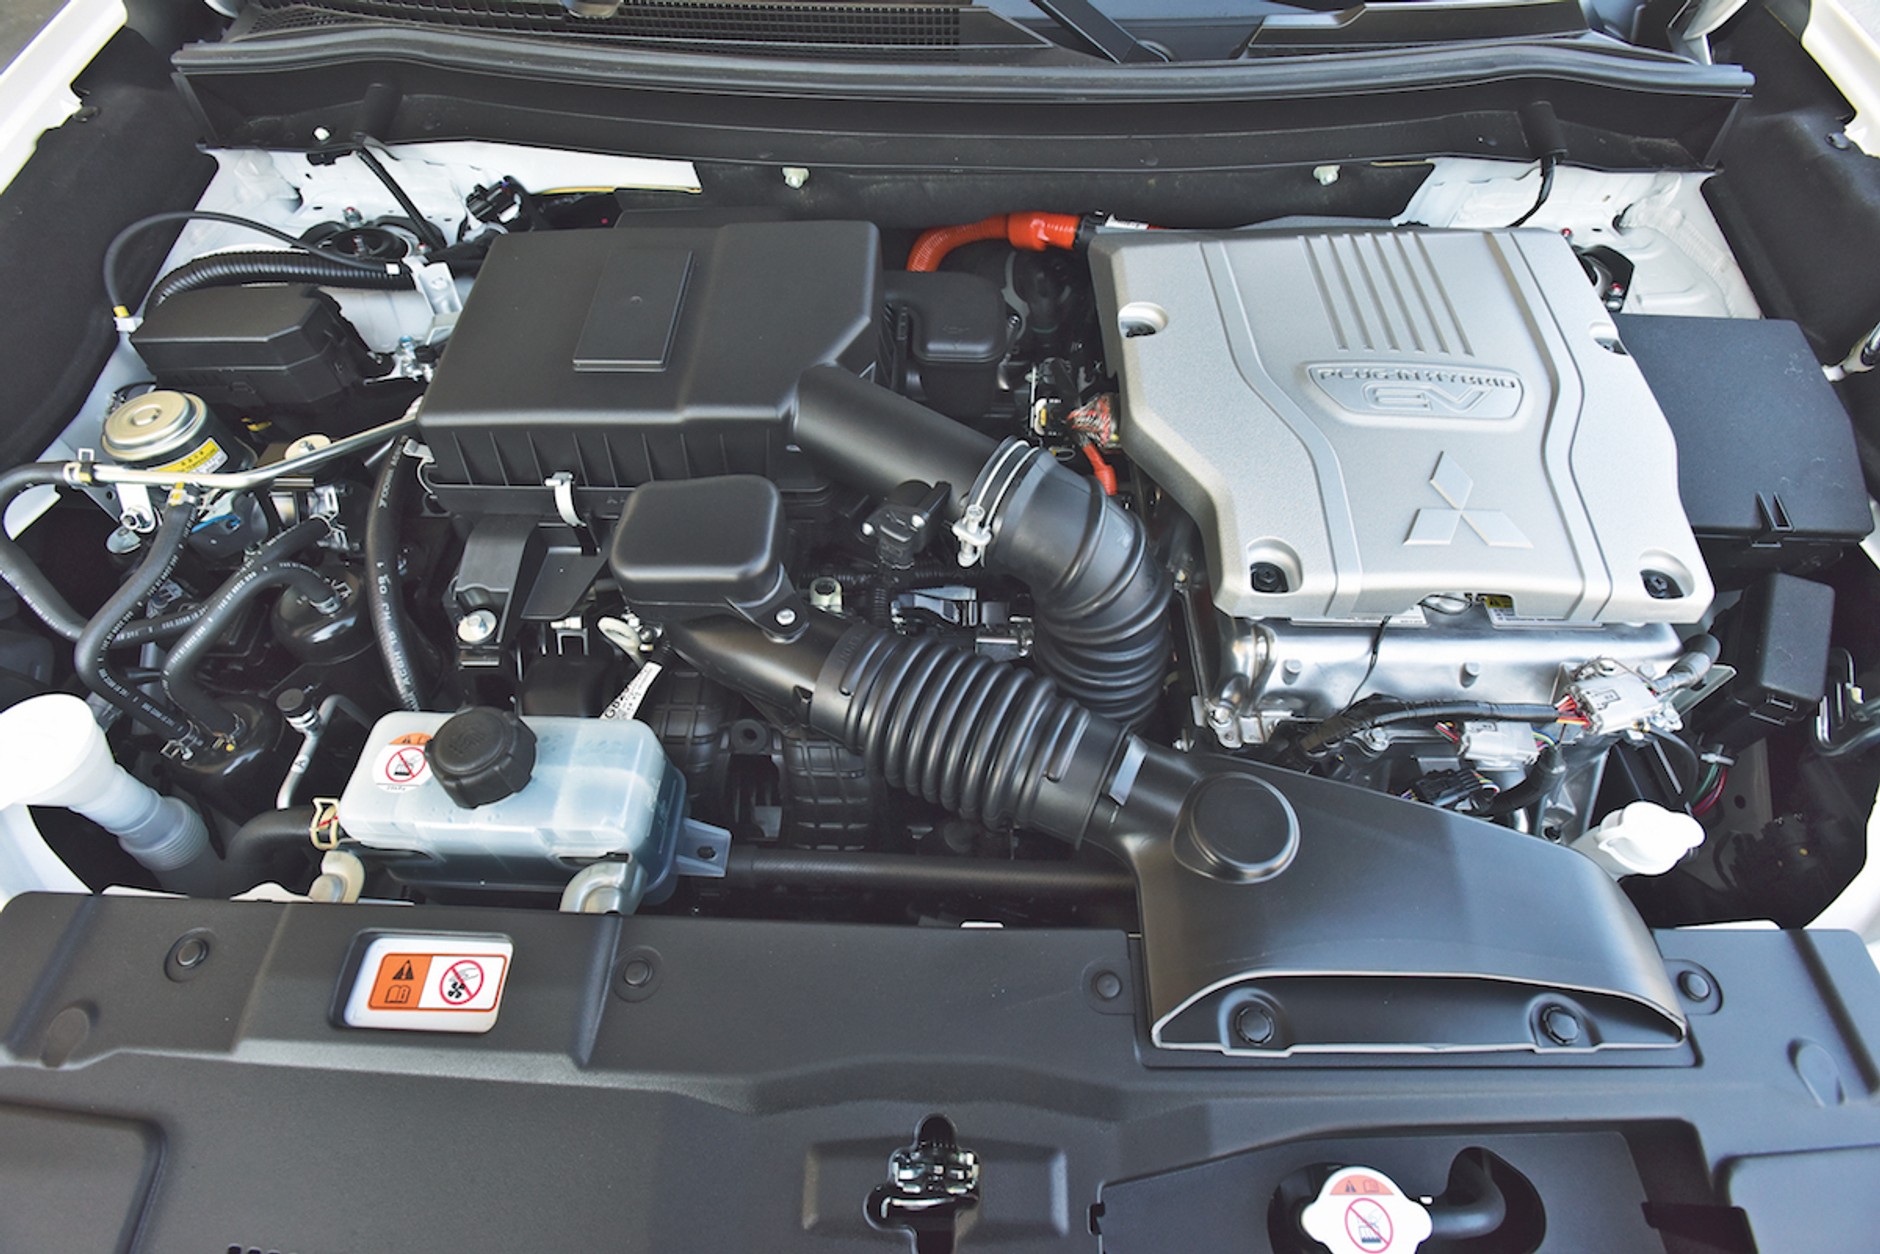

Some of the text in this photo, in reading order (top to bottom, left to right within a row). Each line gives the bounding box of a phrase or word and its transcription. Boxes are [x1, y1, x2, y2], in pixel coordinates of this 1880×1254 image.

[1317, 368, 1517, 389] PLUG-IN HYBRID
[1364, 382, 1491, 413] EV
